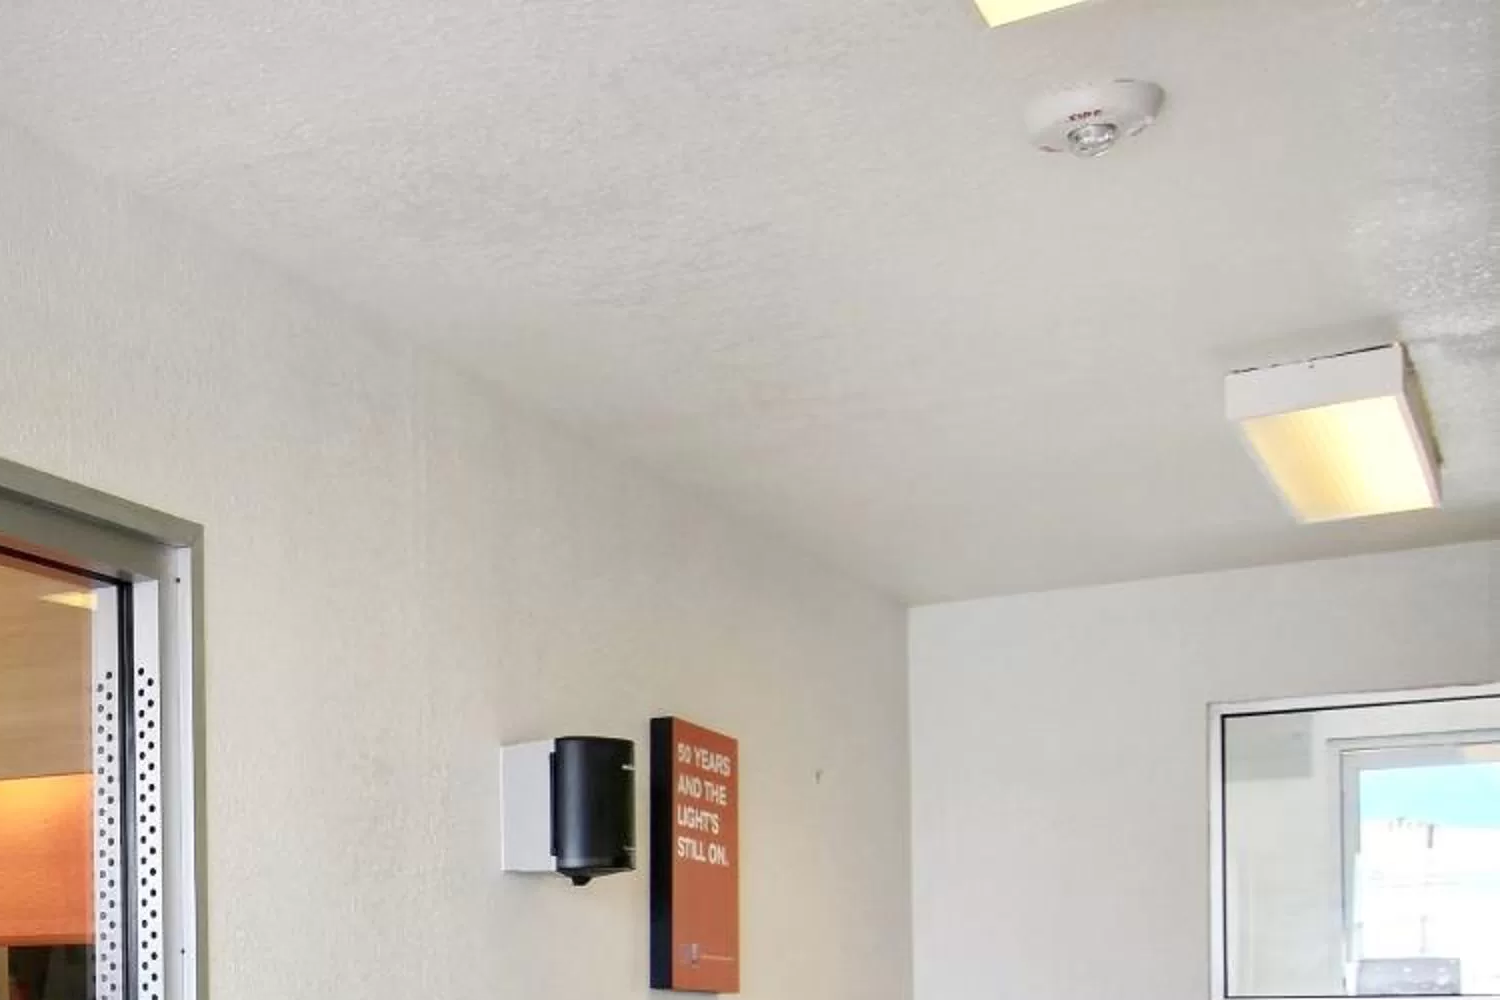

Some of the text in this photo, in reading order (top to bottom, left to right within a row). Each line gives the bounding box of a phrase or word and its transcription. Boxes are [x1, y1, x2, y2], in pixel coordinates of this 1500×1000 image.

[677, 743, 732, 777] 50 YEARS
[677, 773, 728, 806] AND THE
[677, 803, 720, 835] LIGHT'S
[677, 835, 707, 862] STILL
